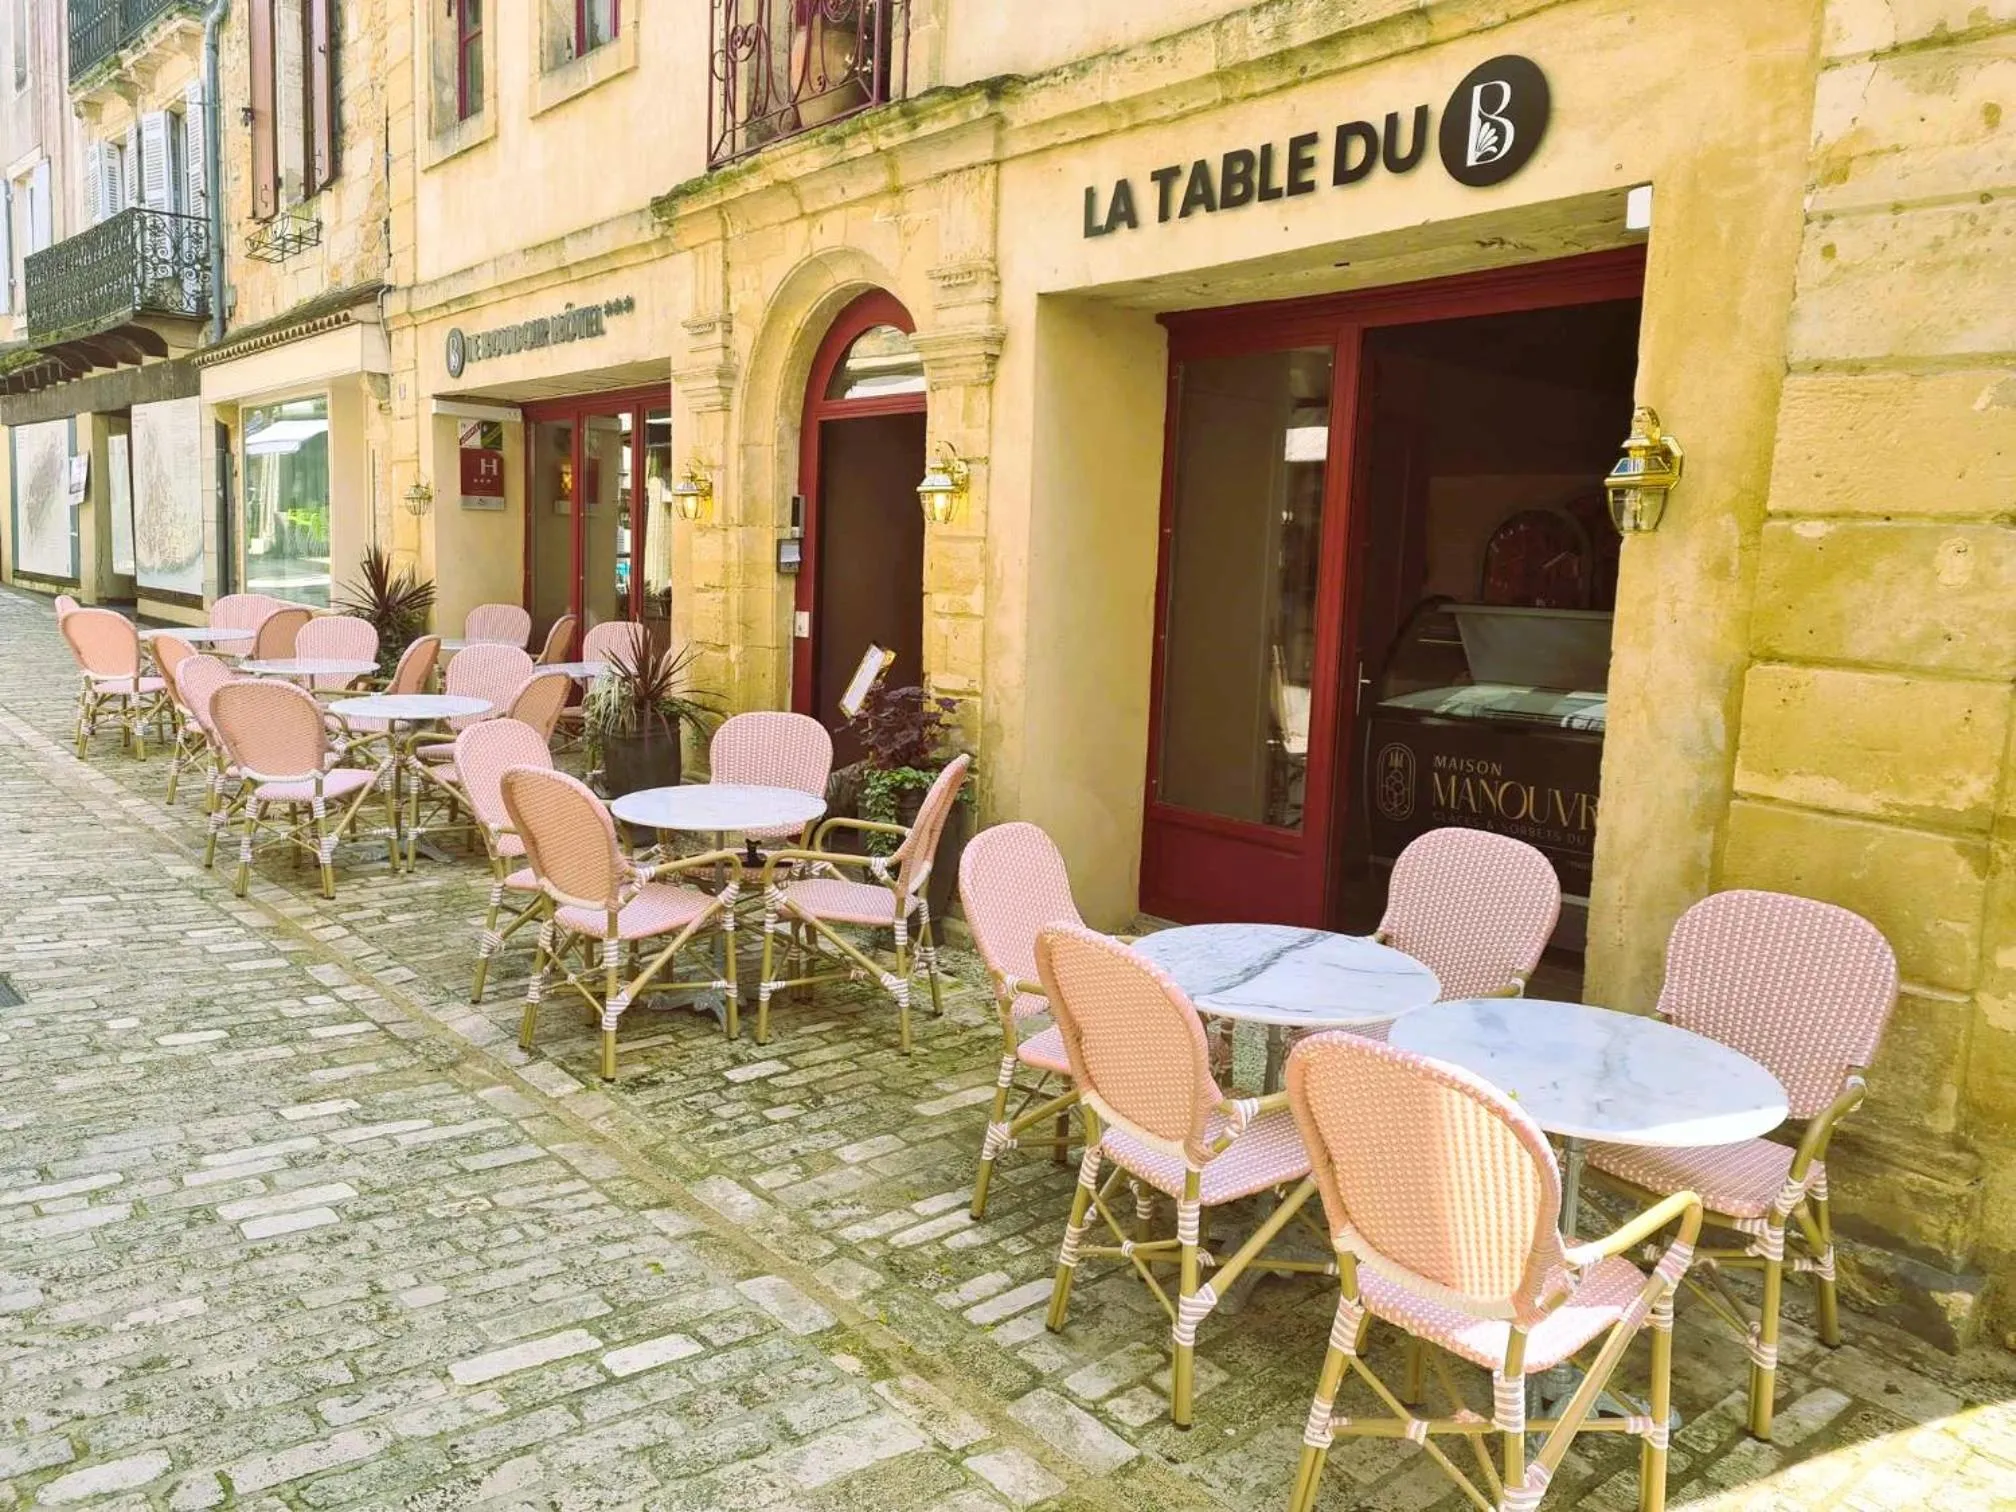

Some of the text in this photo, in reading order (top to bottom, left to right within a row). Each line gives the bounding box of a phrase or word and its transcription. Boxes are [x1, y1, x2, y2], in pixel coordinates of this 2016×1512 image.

[1084, 80, 1515, 238] LA TABLE DU B
[480, 458, 498, 476] H
[1433, 755, 1502, 776] MAISON
[1502, 821, 1562, 842] SORBETS
[1567, 833, 1586, 846] DU
